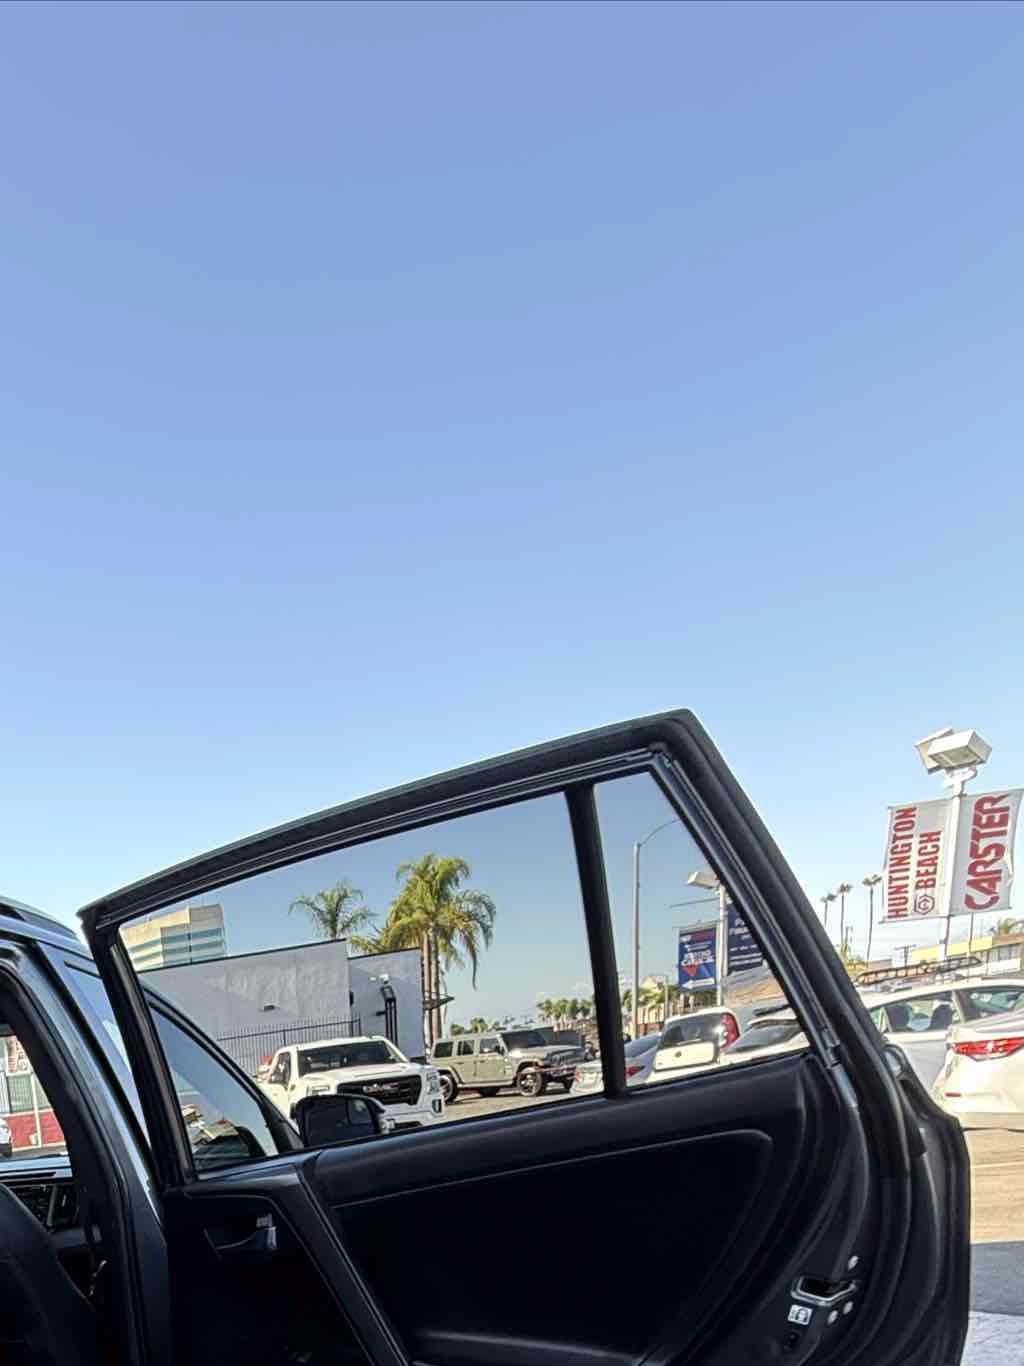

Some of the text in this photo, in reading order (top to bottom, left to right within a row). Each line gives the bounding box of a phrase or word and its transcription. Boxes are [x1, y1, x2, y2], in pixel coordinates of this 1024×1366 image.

[887, 807, 918, 919] HUNTINGTON
[915, 830, 942, 890] BEACH
[964, 793, 1011, 911] CARSTER
